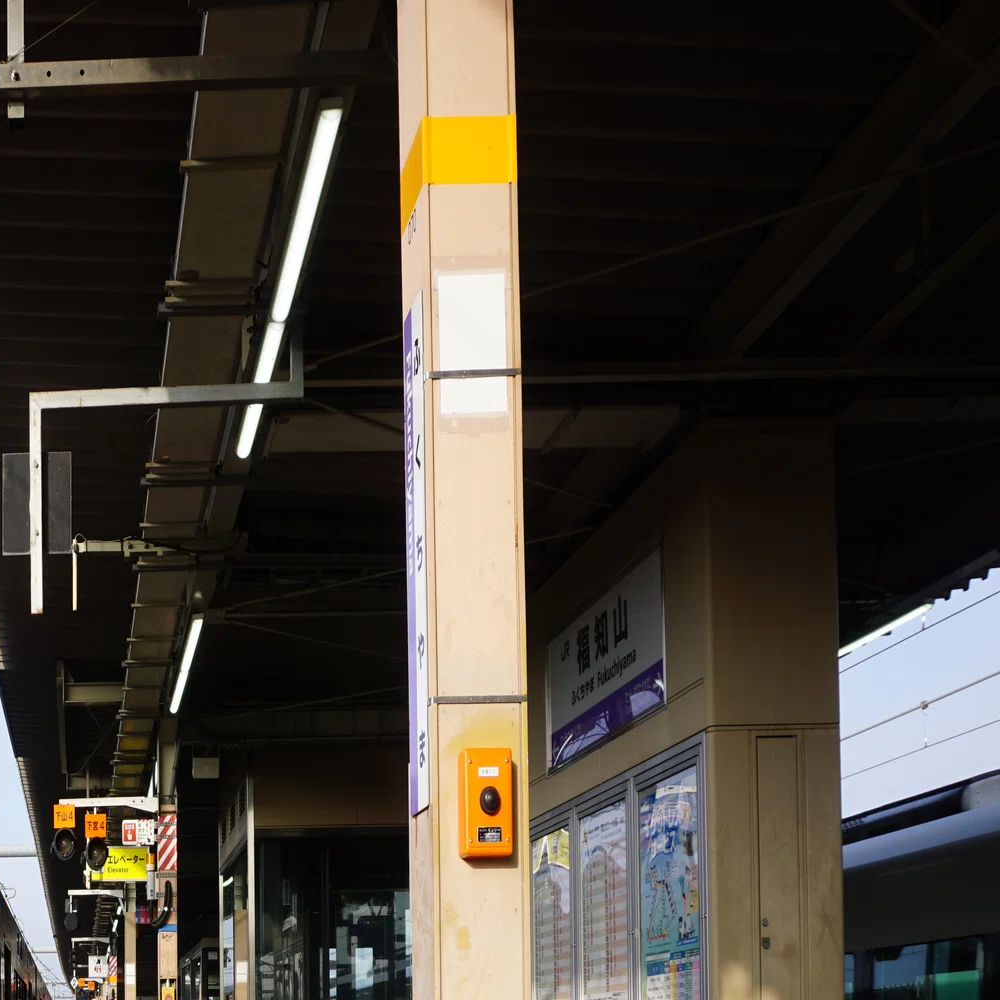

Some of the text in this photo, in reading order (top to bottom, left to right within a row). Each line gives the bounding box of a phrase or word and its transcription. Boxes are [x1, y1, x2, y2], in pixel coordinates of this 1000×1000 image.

[405, 350, 415, 576] Fukuchiyama
[413, 338, 426, 768] ふくちやま
[561, 595, 628, 676] JR 福知山
[571, 648, 637, 706] ふくちやま Fukuchiyama
[107, 854, 145, 864] エレベーター
[107, 866, 130, 874] Elevator
